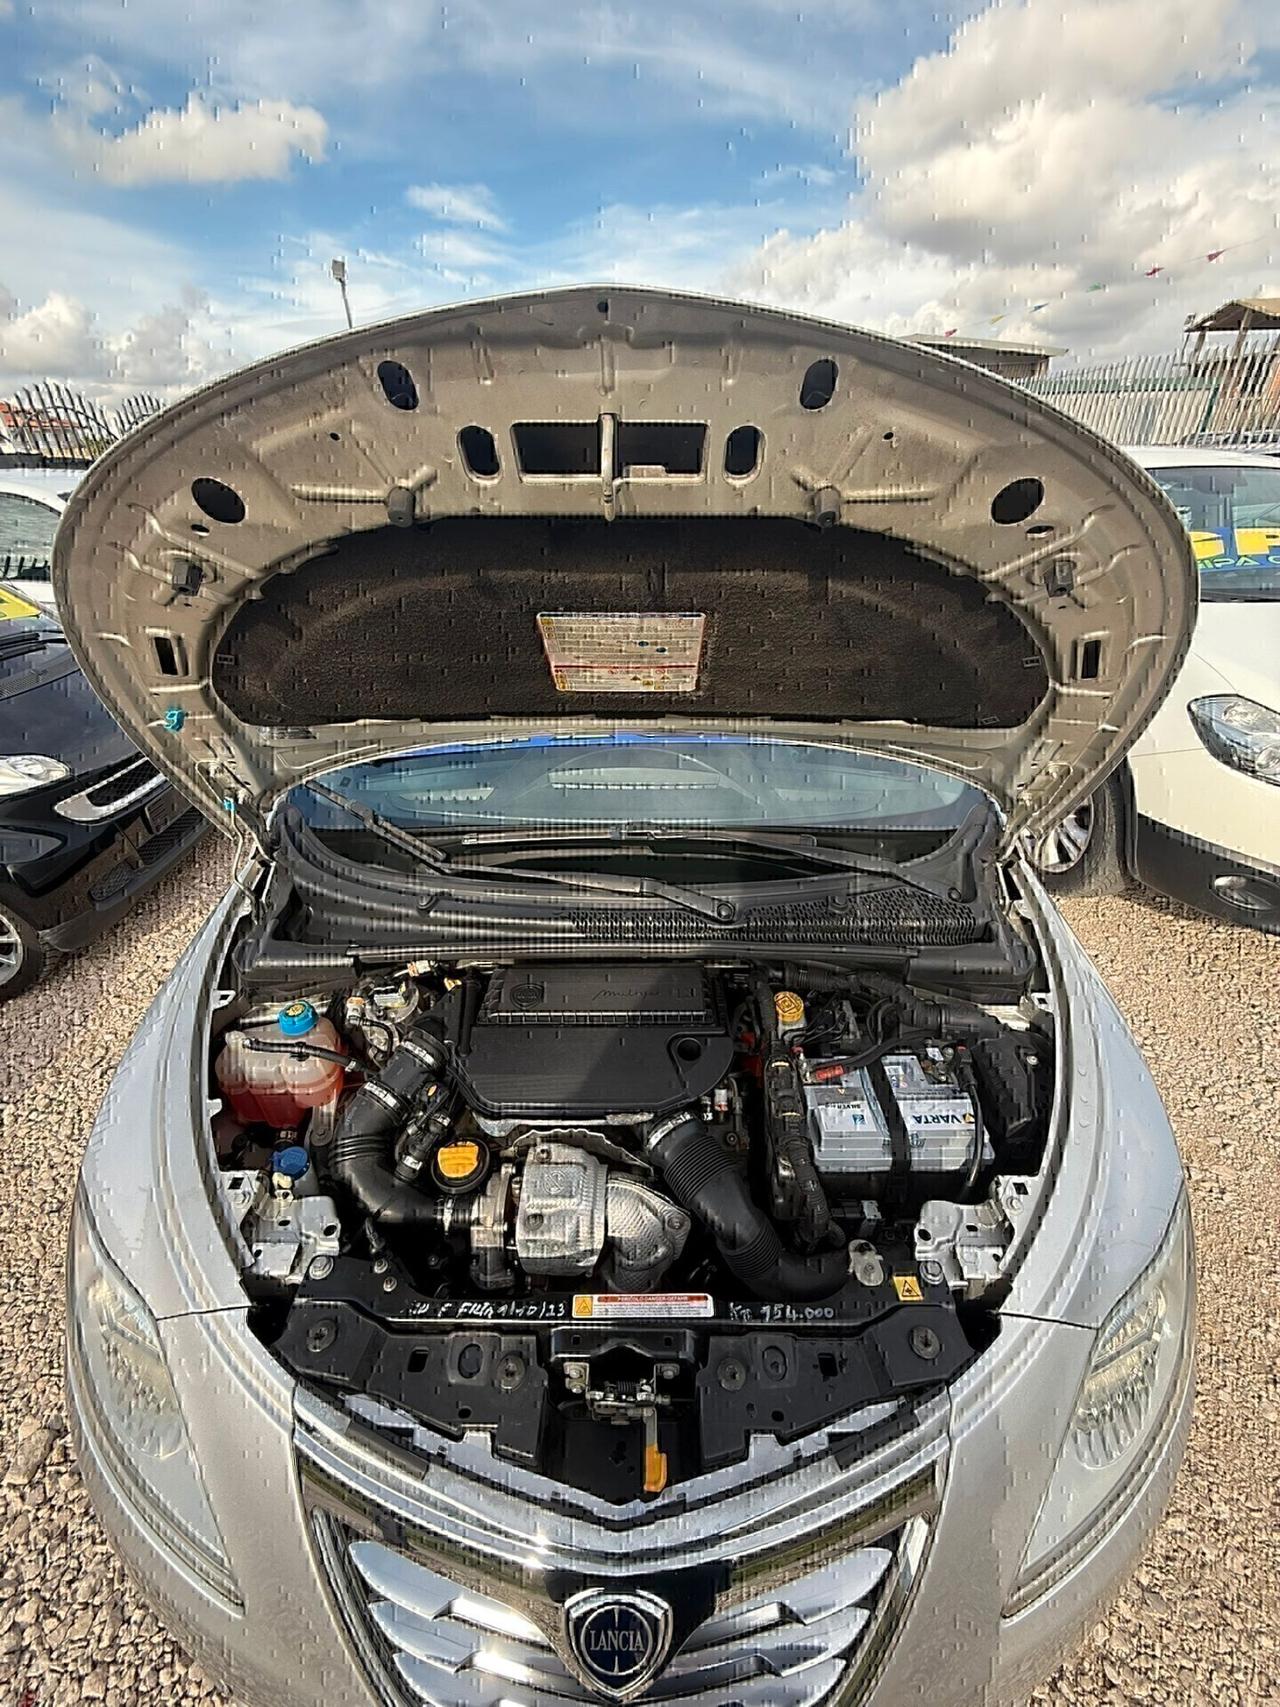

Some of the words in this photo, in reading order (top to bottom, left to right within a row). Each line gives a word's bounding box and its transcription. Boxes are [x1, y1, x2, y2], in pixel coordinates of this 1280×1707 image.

[912, 1115, 962, 1124] VARTA
[760, 1303, 834, 1322] 154.000
[589, 1630, 646, 1651] LANCIA
